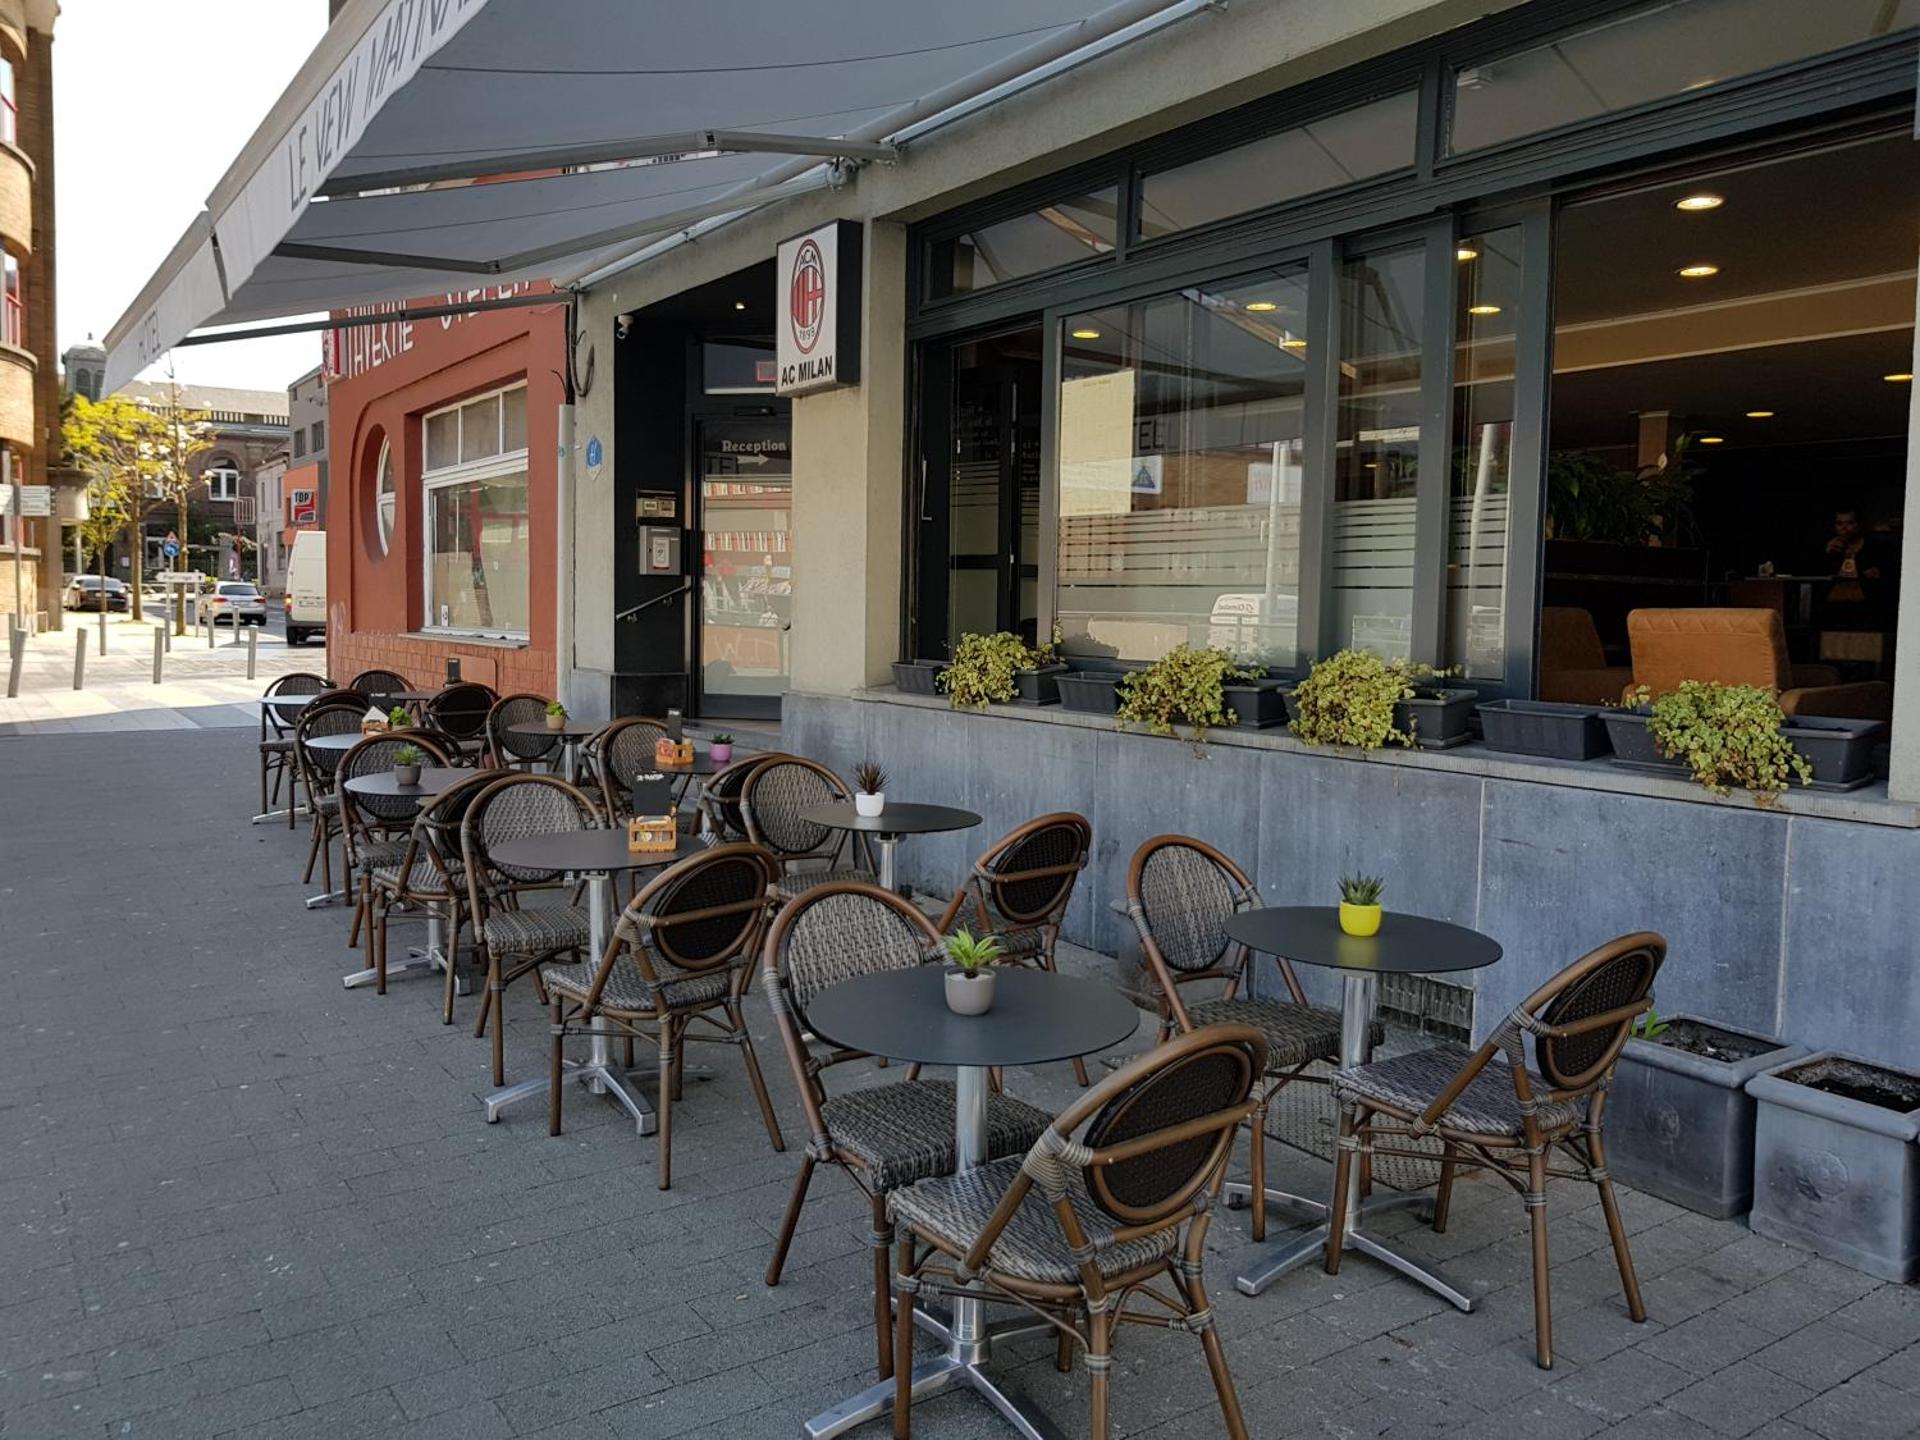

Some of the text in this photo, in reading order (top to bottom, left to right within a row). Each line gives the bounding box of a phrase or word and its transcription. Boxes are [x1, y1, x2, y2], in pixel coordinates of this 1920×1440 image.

[781, 354, 833, 387] AC MILAN
[722, 440, 787, 454] Reception
